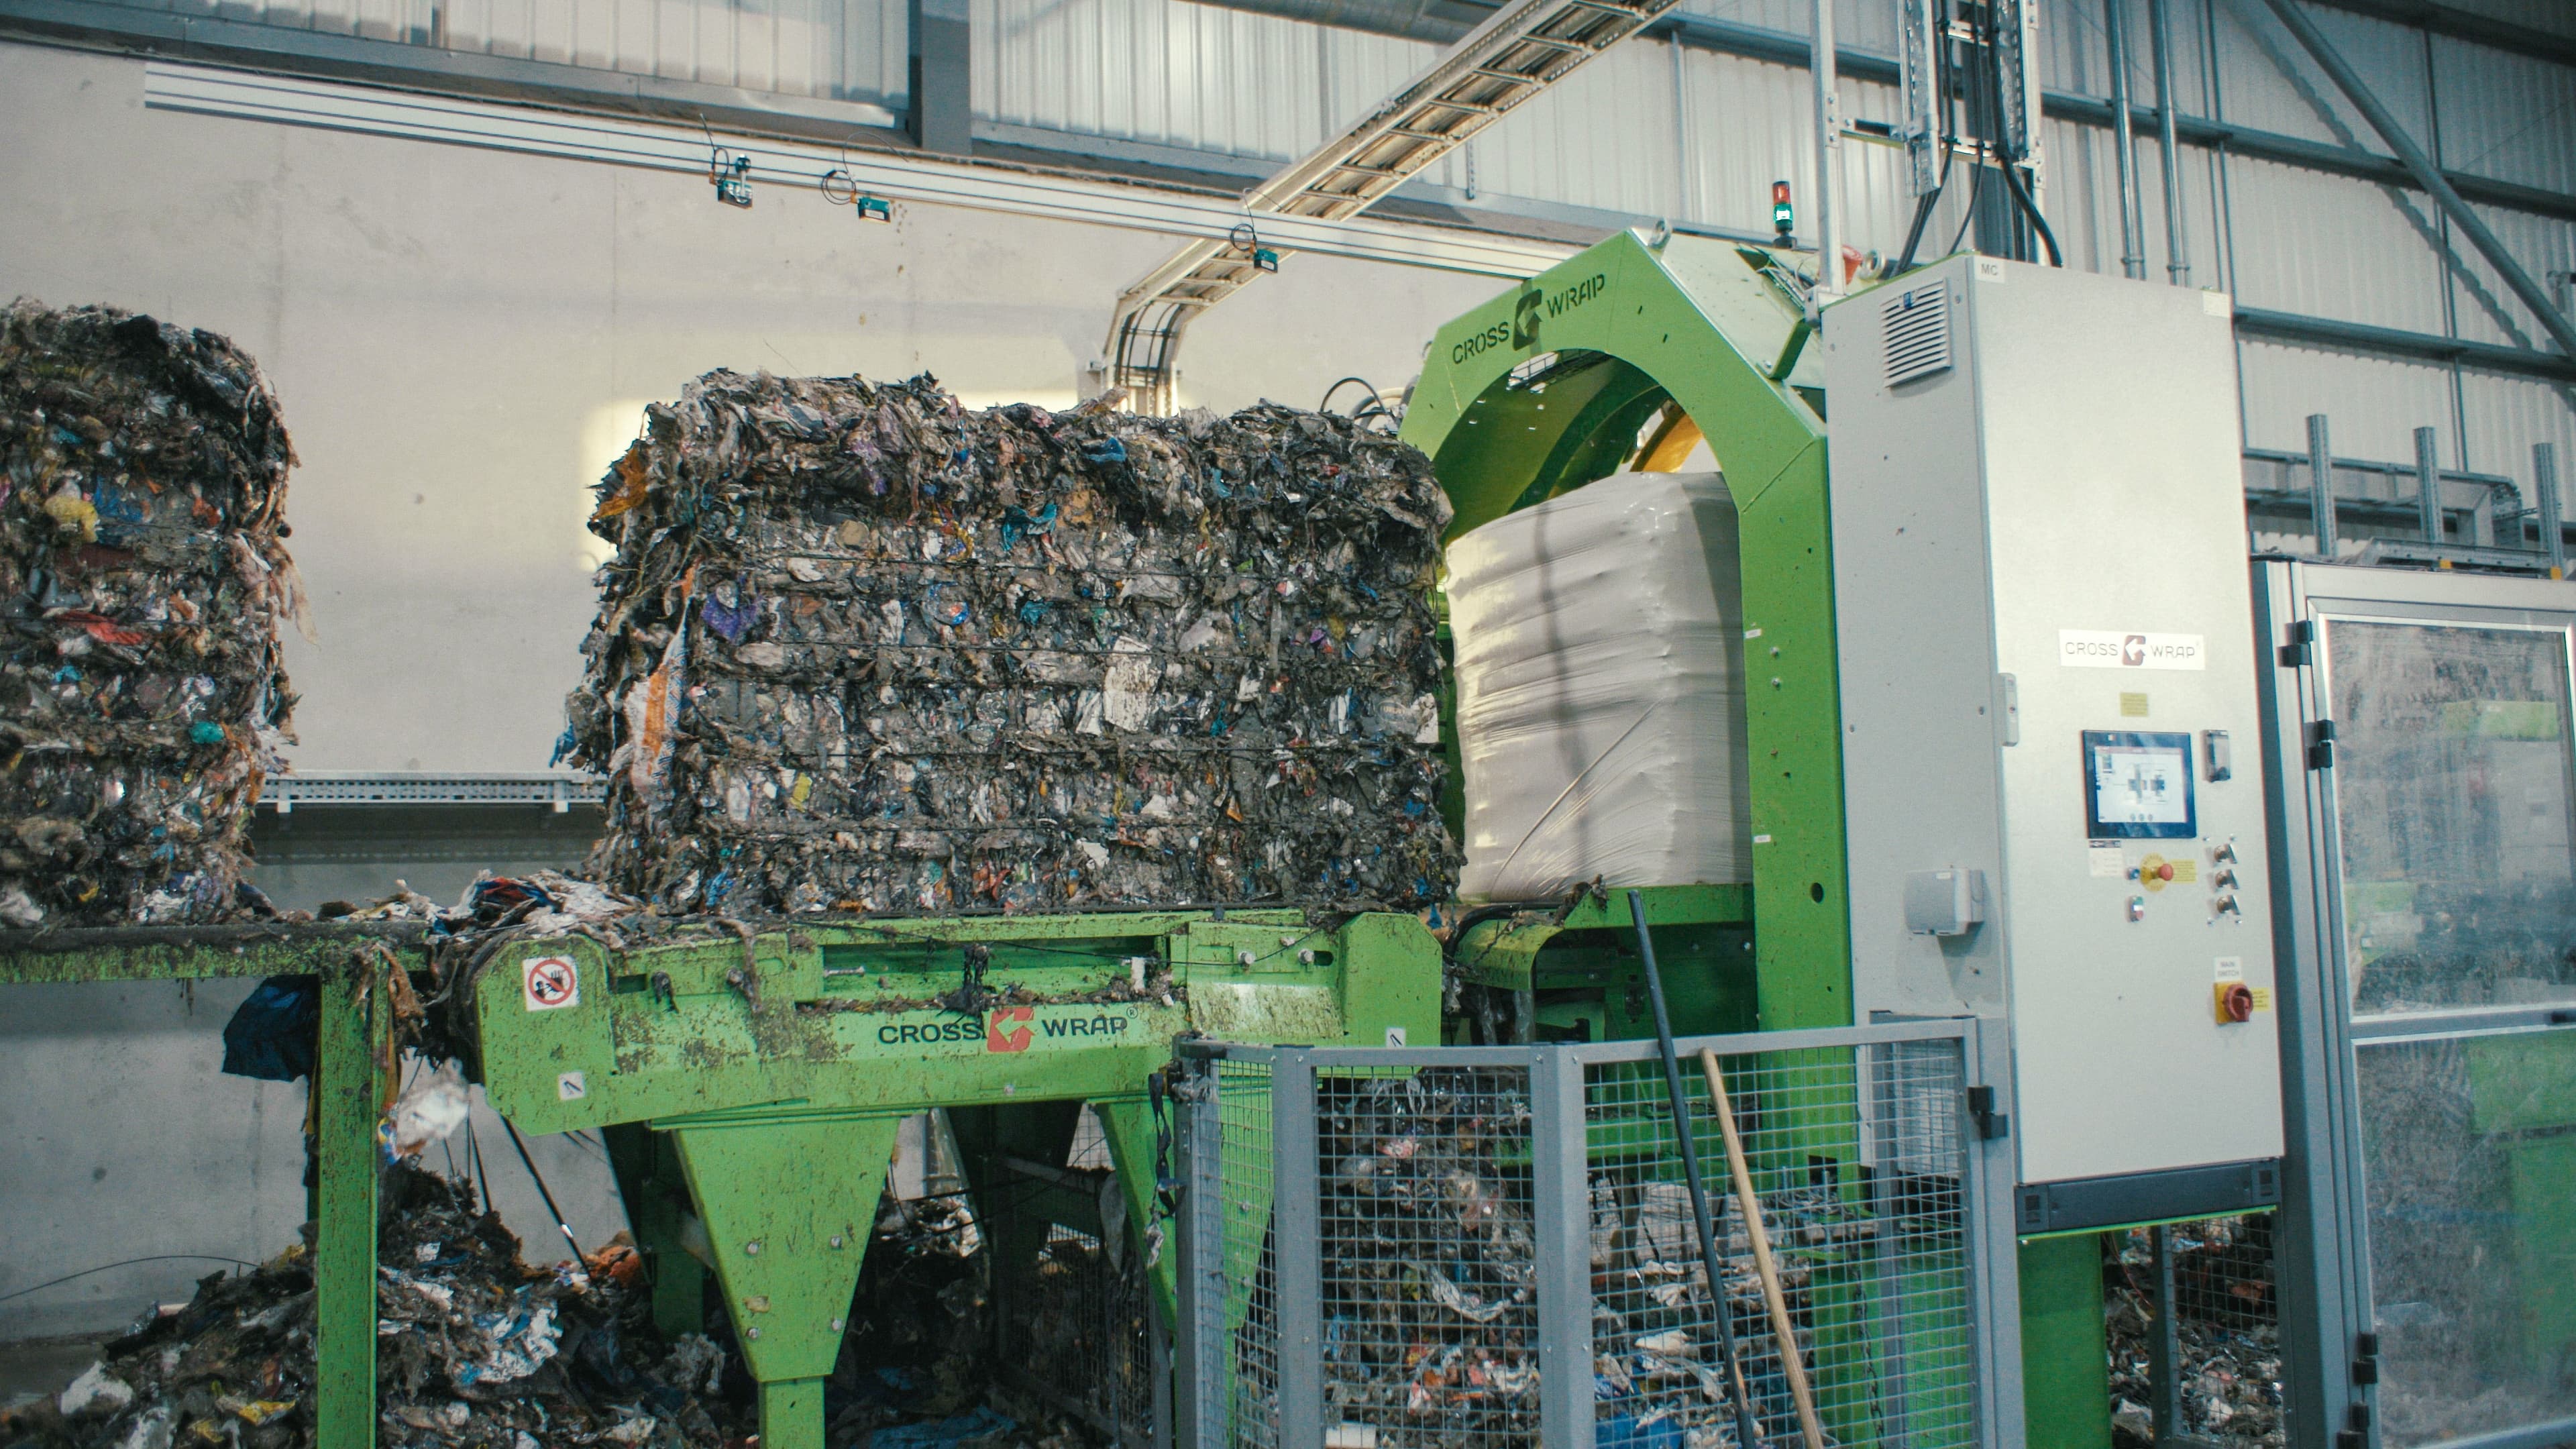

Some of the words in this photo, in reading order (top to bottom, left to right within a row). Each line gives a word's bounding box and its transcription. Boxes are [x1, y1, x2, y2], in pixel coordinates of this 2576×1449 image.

[1981, 263, 1998, 276] MC
[1452, 321, 1509, 364] CROSS
[1547, 273, 1605, 319] WRAP
[2065, 642, 2118, 656] CROSS
[2151, 645, 2195, 658] WRAP
[878, 1022, 981, 1044] CROSS
